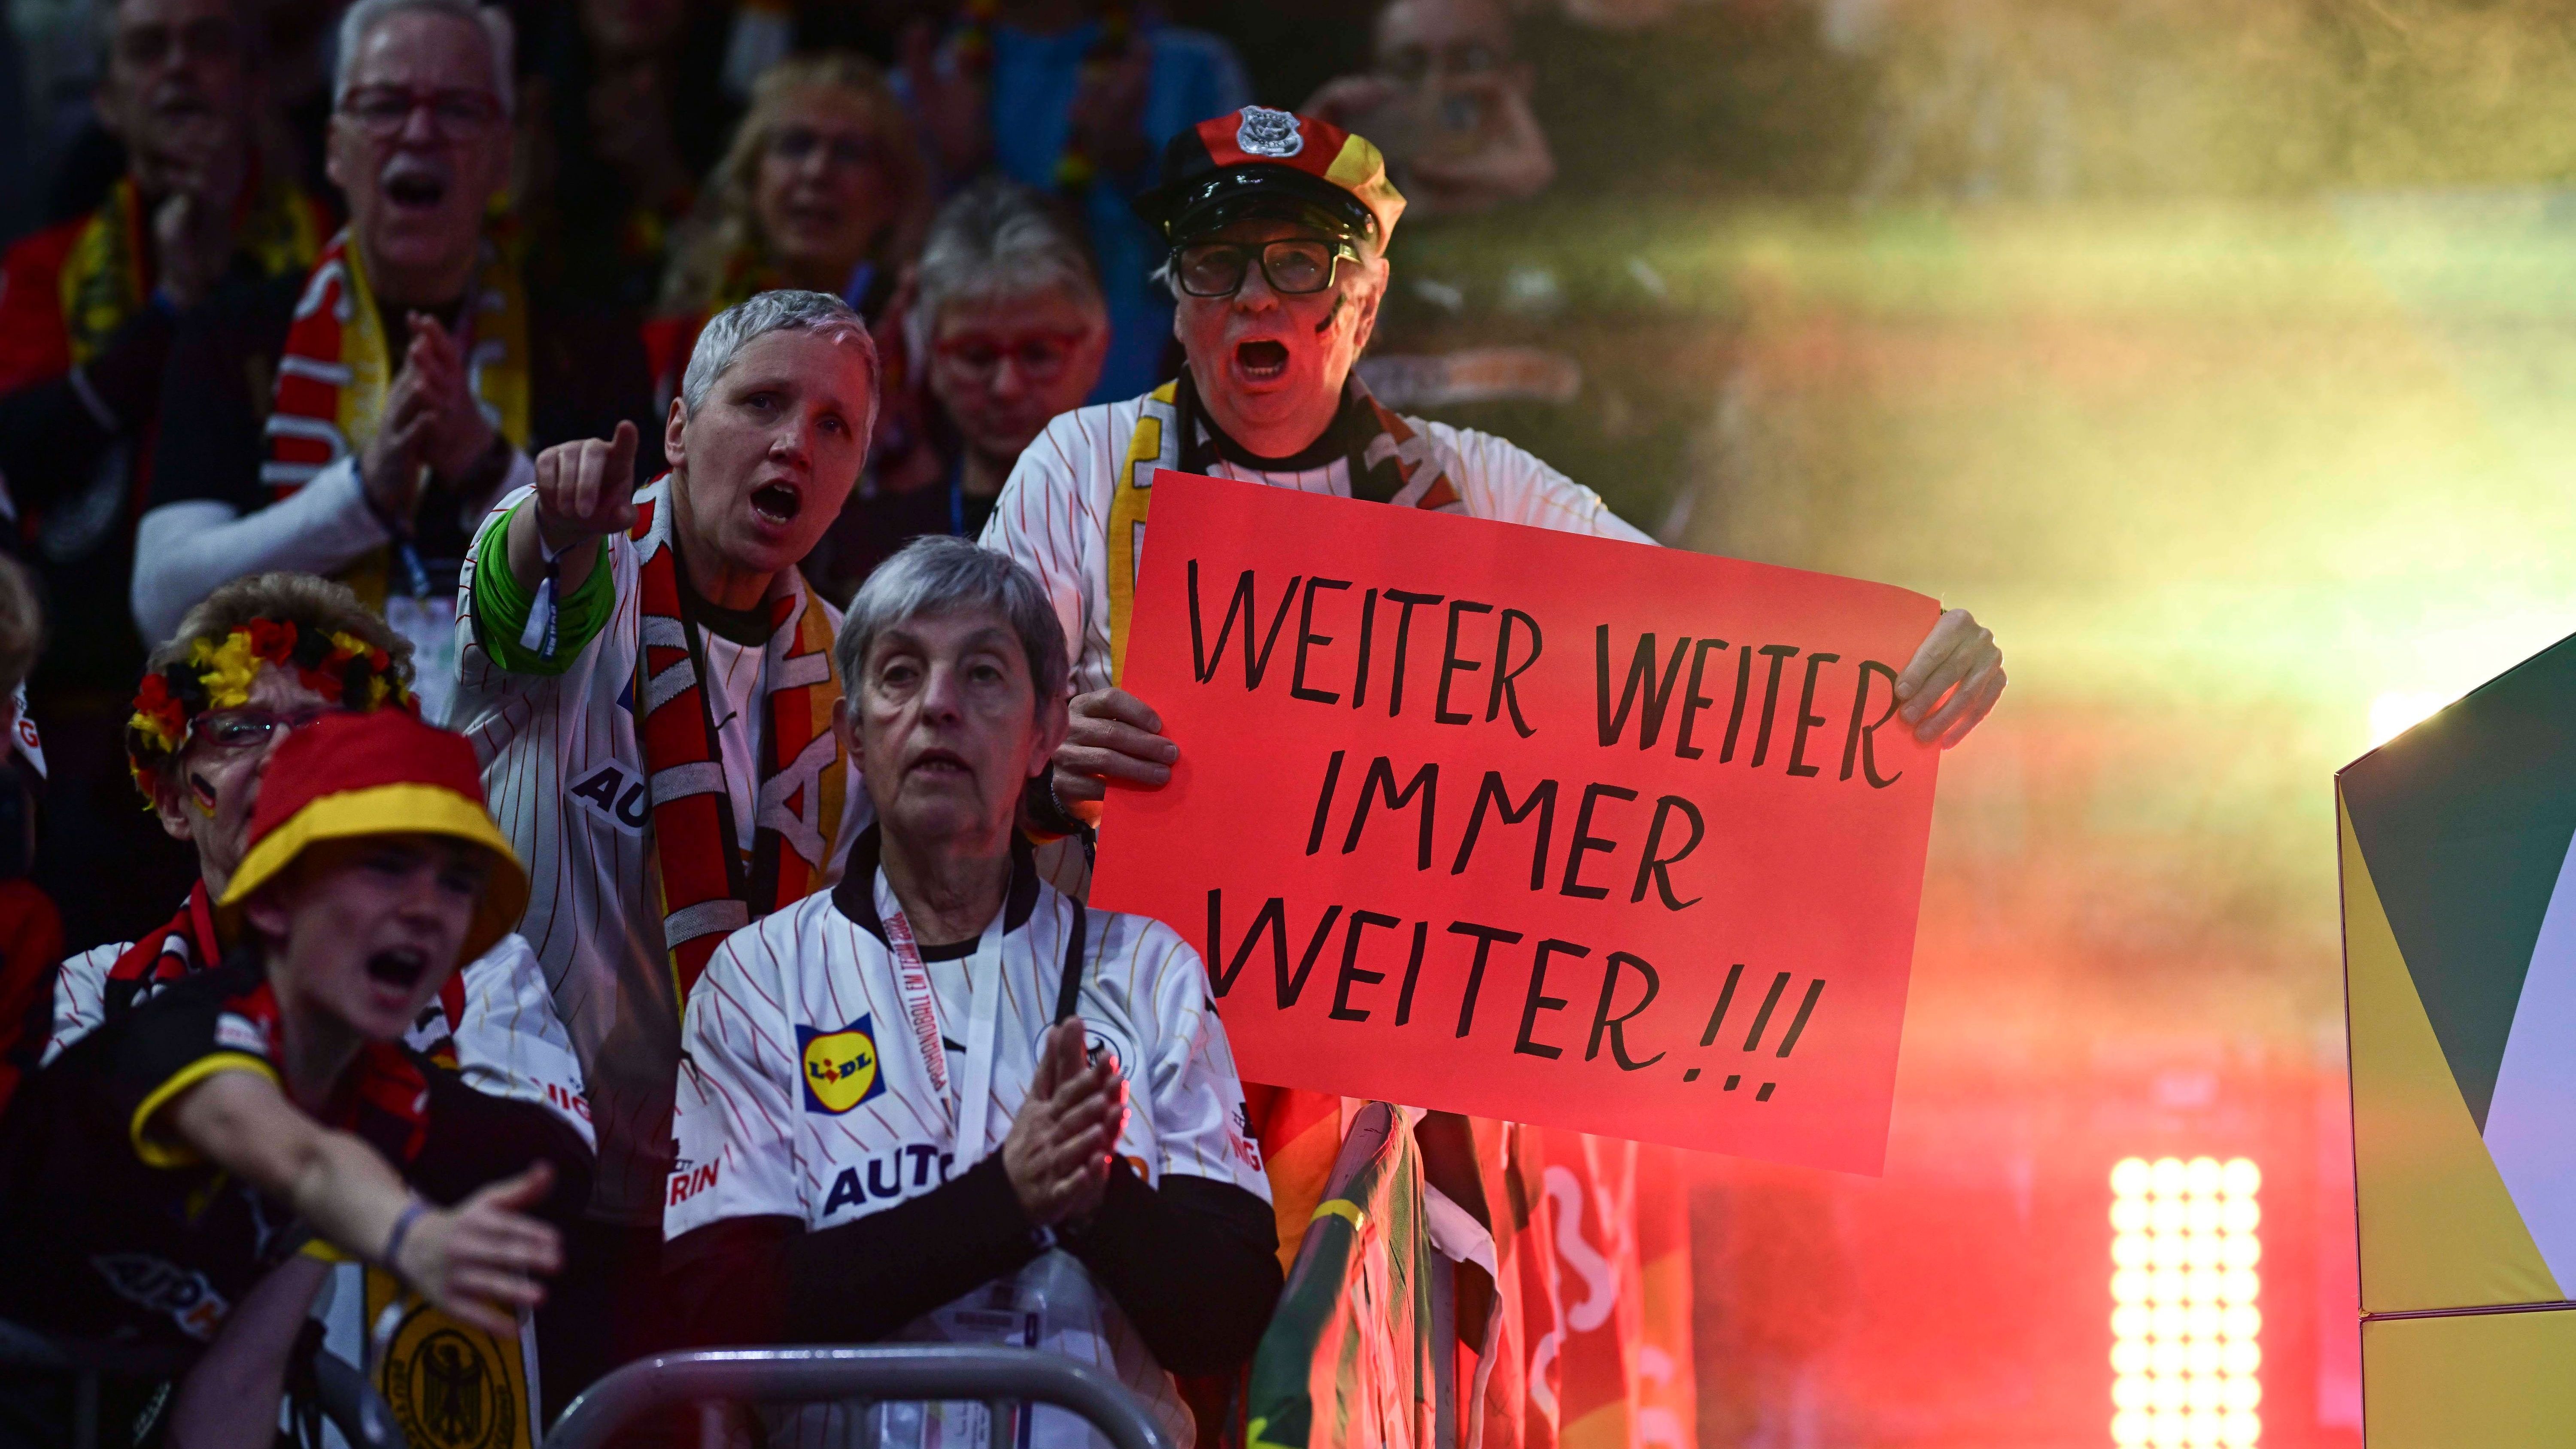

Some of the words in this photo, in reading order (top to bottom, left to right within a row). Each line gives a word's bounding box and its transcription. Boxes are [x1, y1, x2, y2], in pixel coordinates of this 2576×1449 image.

[1188, 559, 1542, 738] WEITER
[1596, 624, 1902, 789] WEITER
[1306, 750, 1704, 911] IMMER
[1207, 888, 1666, 1071] WEITER
[1683, 964, 1825, 1102] !!!
